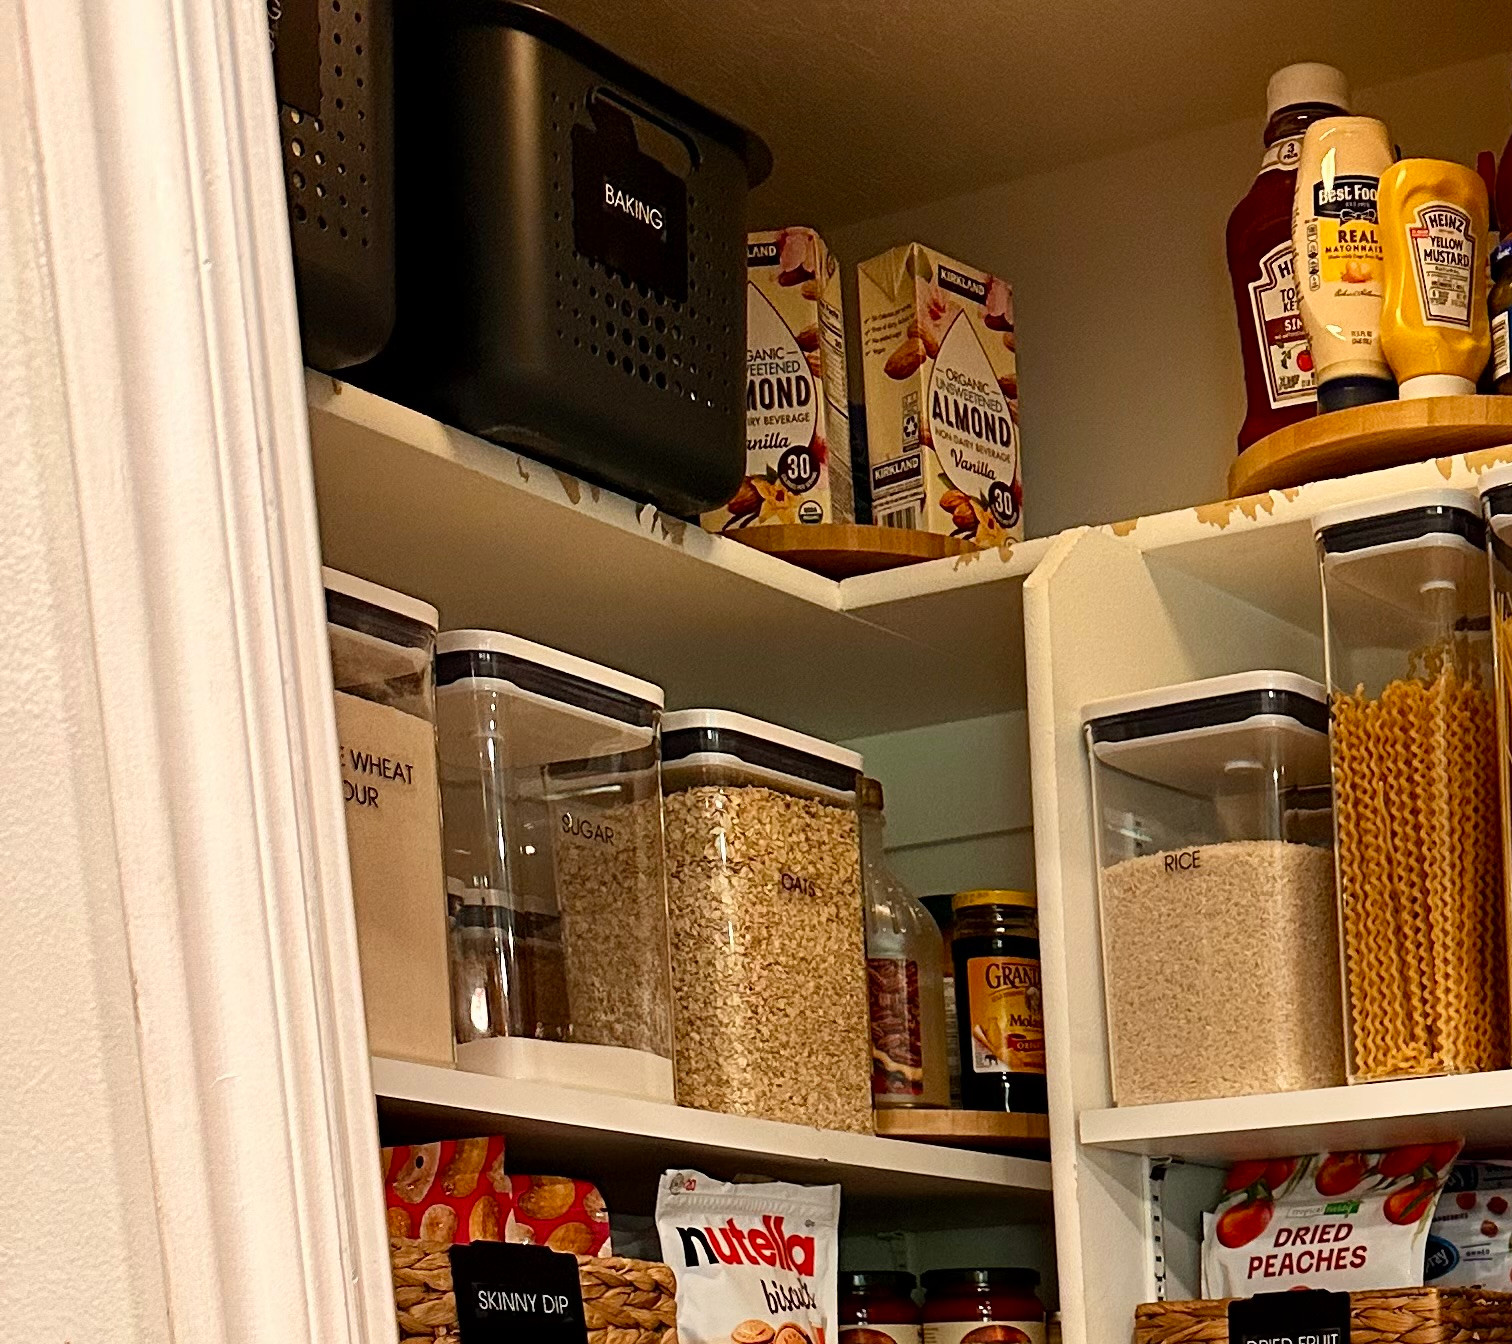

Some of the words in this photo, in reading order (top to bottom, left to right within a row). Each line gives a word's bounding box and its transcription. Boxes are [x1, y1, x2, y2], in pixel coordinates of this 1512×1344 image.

[604, 184, 664, 233] BAKING
[1429, 214, 1465, 231] HEINZ
[1338, 228, 1377, 245] REAL
[1430, 235, 1464, 251] YELLOW
[1423, 248, 1470, 267] MUSTARD
[940, 267, 985, 296] KIRKLAND
[935, 376, 1002, 413] UNSWEETENED
[945, 367, 989, 396] ORGANIC
[764, 412, 810, 426] BEVERAGE
[932, 391, 1012, 448] ALMOND
[787, 455, 809, 479] 30
[875, 456, 920, 480] KIRKLAND
[950, 448, 997, 481] Vanilla
[994, 484, 1013, 517] 30
[350, 749, 414, 785] WHEAT
[561, 811, 615, 846] SUGAR
[1164, 847, 1201, 873] RICE
[781, 872, 817, 899] OATS
[676, 1214, 816, 1278] nutella
[1272, 1223, 1354, 1249] DRIED
[1246, 1244, 1369, 1280] PEACHES
[477, 1289, 537, 1314] SKINNY
[541, 1294, 569, 1315] DIP
